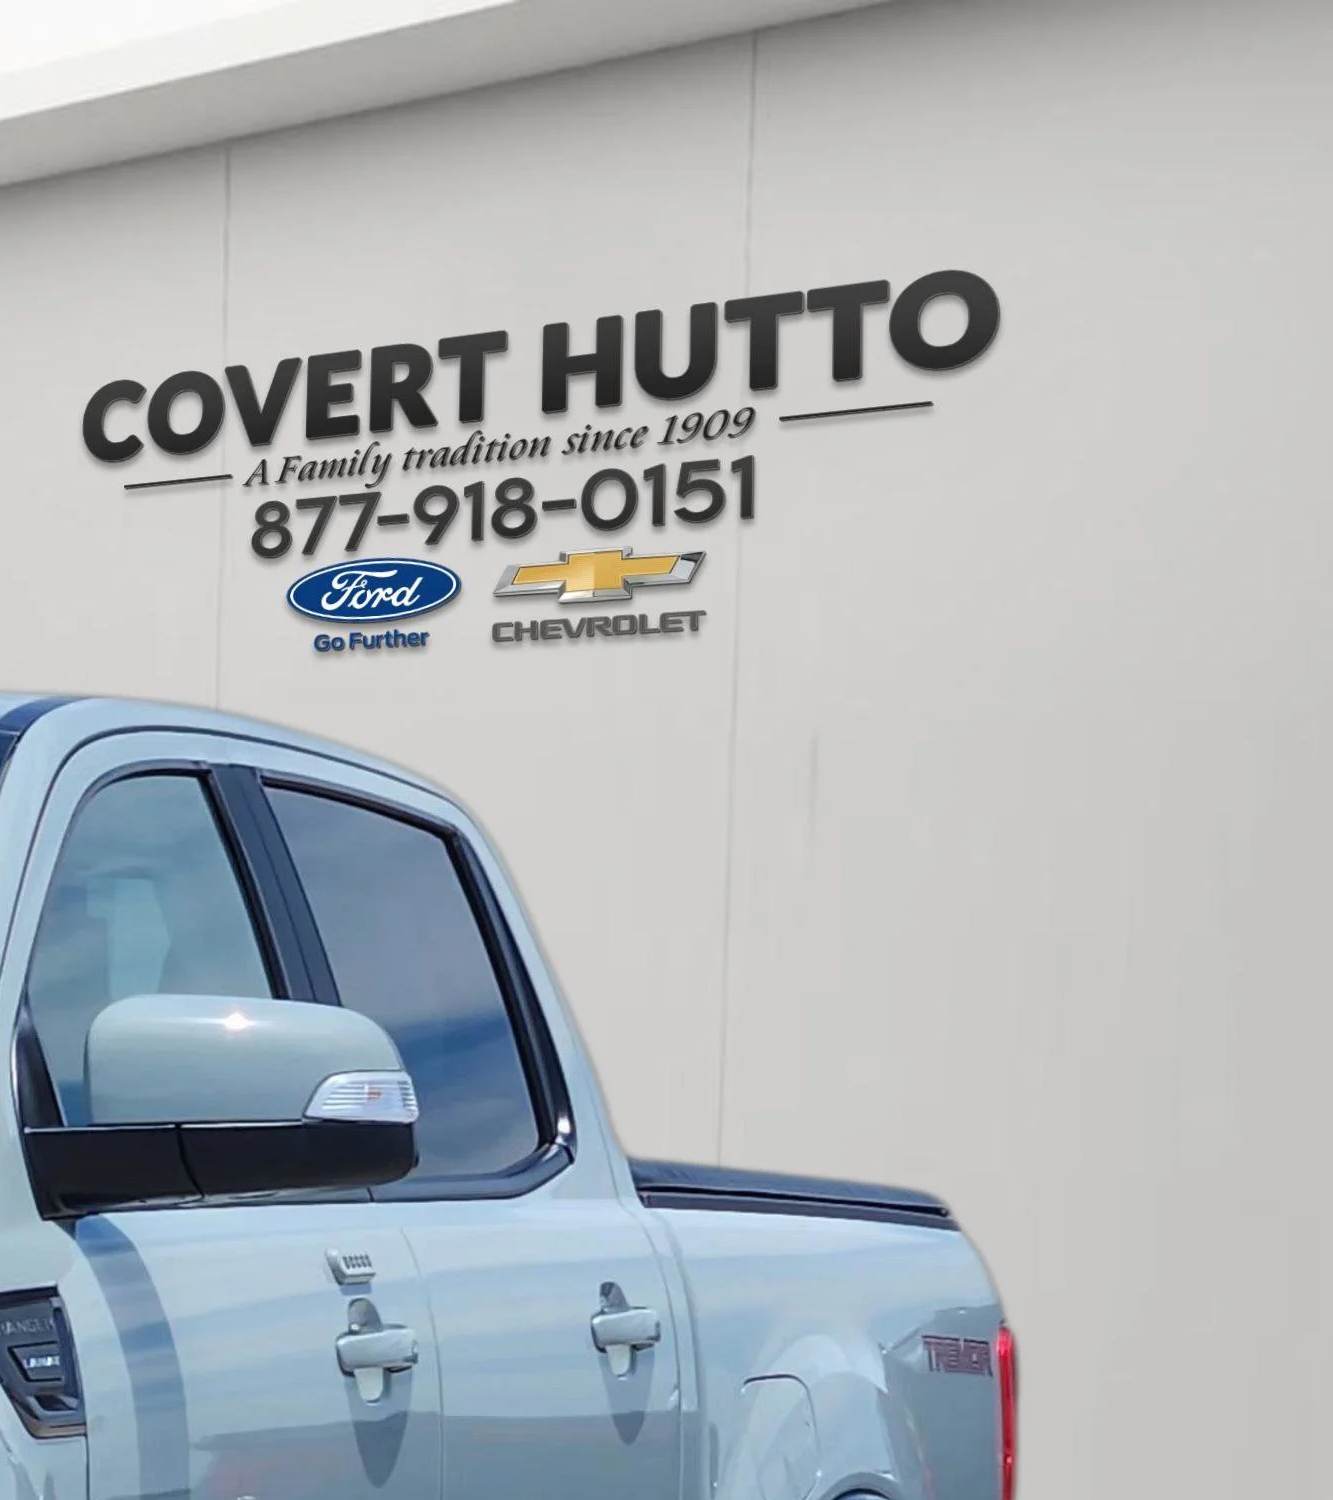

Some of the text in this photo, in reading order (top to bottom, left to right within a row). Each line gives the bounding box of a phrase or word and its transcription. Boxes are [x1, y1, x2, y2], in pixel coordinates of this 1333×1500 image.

[82, 269, 1001, 464] COVERT HUTTO
[242, 406, 756, 489] A Family tradition since 1909
[251, 454, 755, 560] 877-918-0151
[320, 569, 421, 612] Ford
[313, 628, 430, 653] Go Further
[491, 610, 707, 643] CHEVROLET
